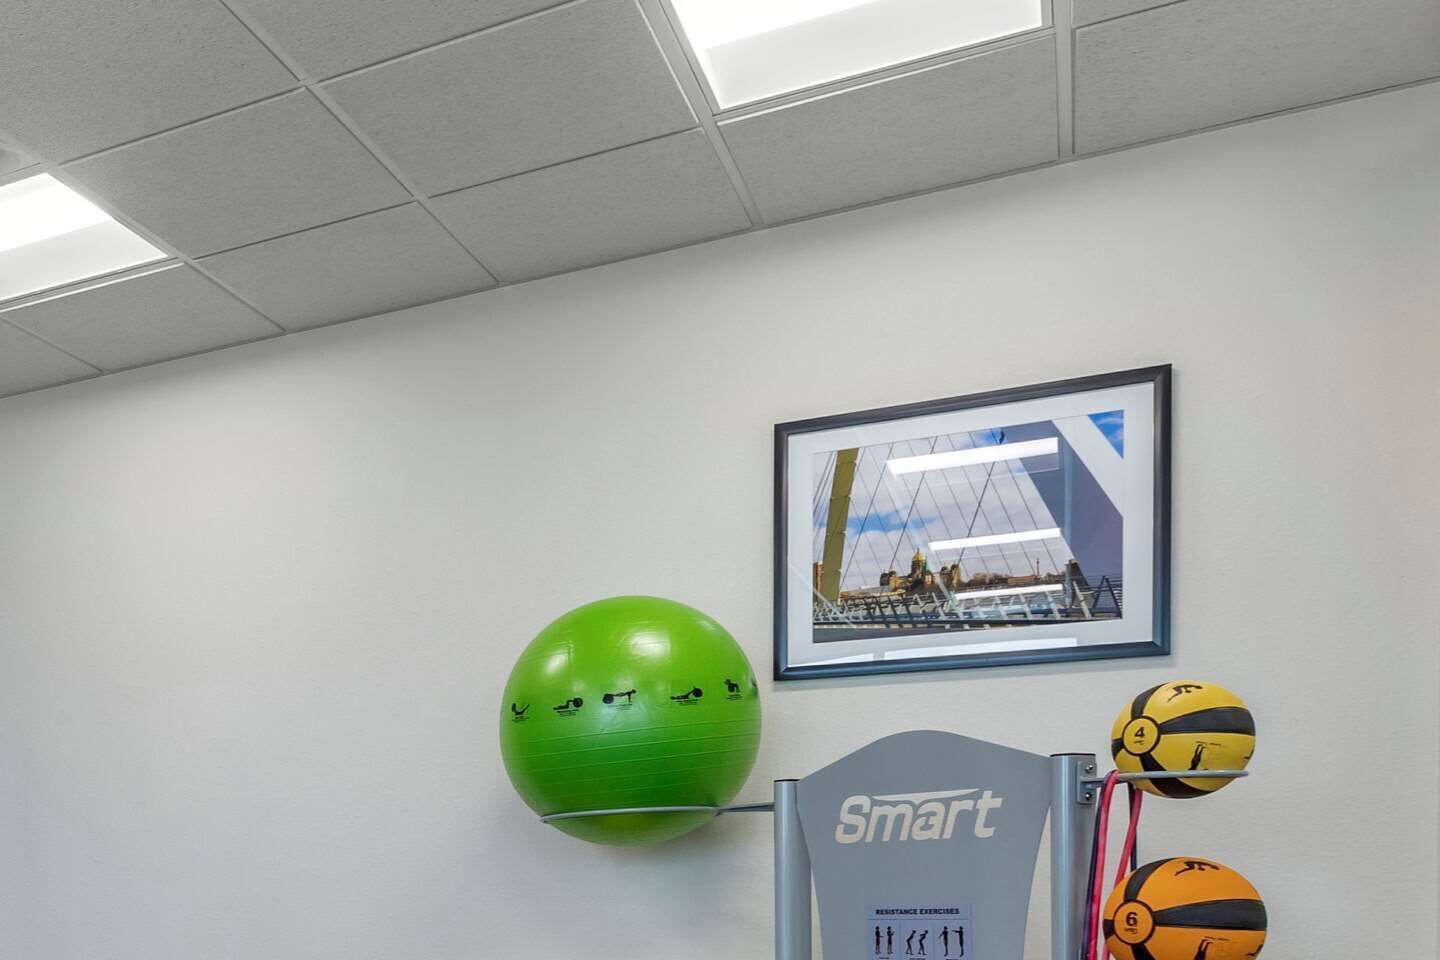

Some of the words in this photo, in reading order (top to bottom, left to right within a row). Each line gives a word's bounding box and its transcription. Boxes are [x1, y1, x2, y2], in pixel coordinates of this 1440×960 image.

[1134, 726, 1146, 738] 4
[834, 788, 1003, 844] Smart
[1125, 911, 1138, 927] 6
